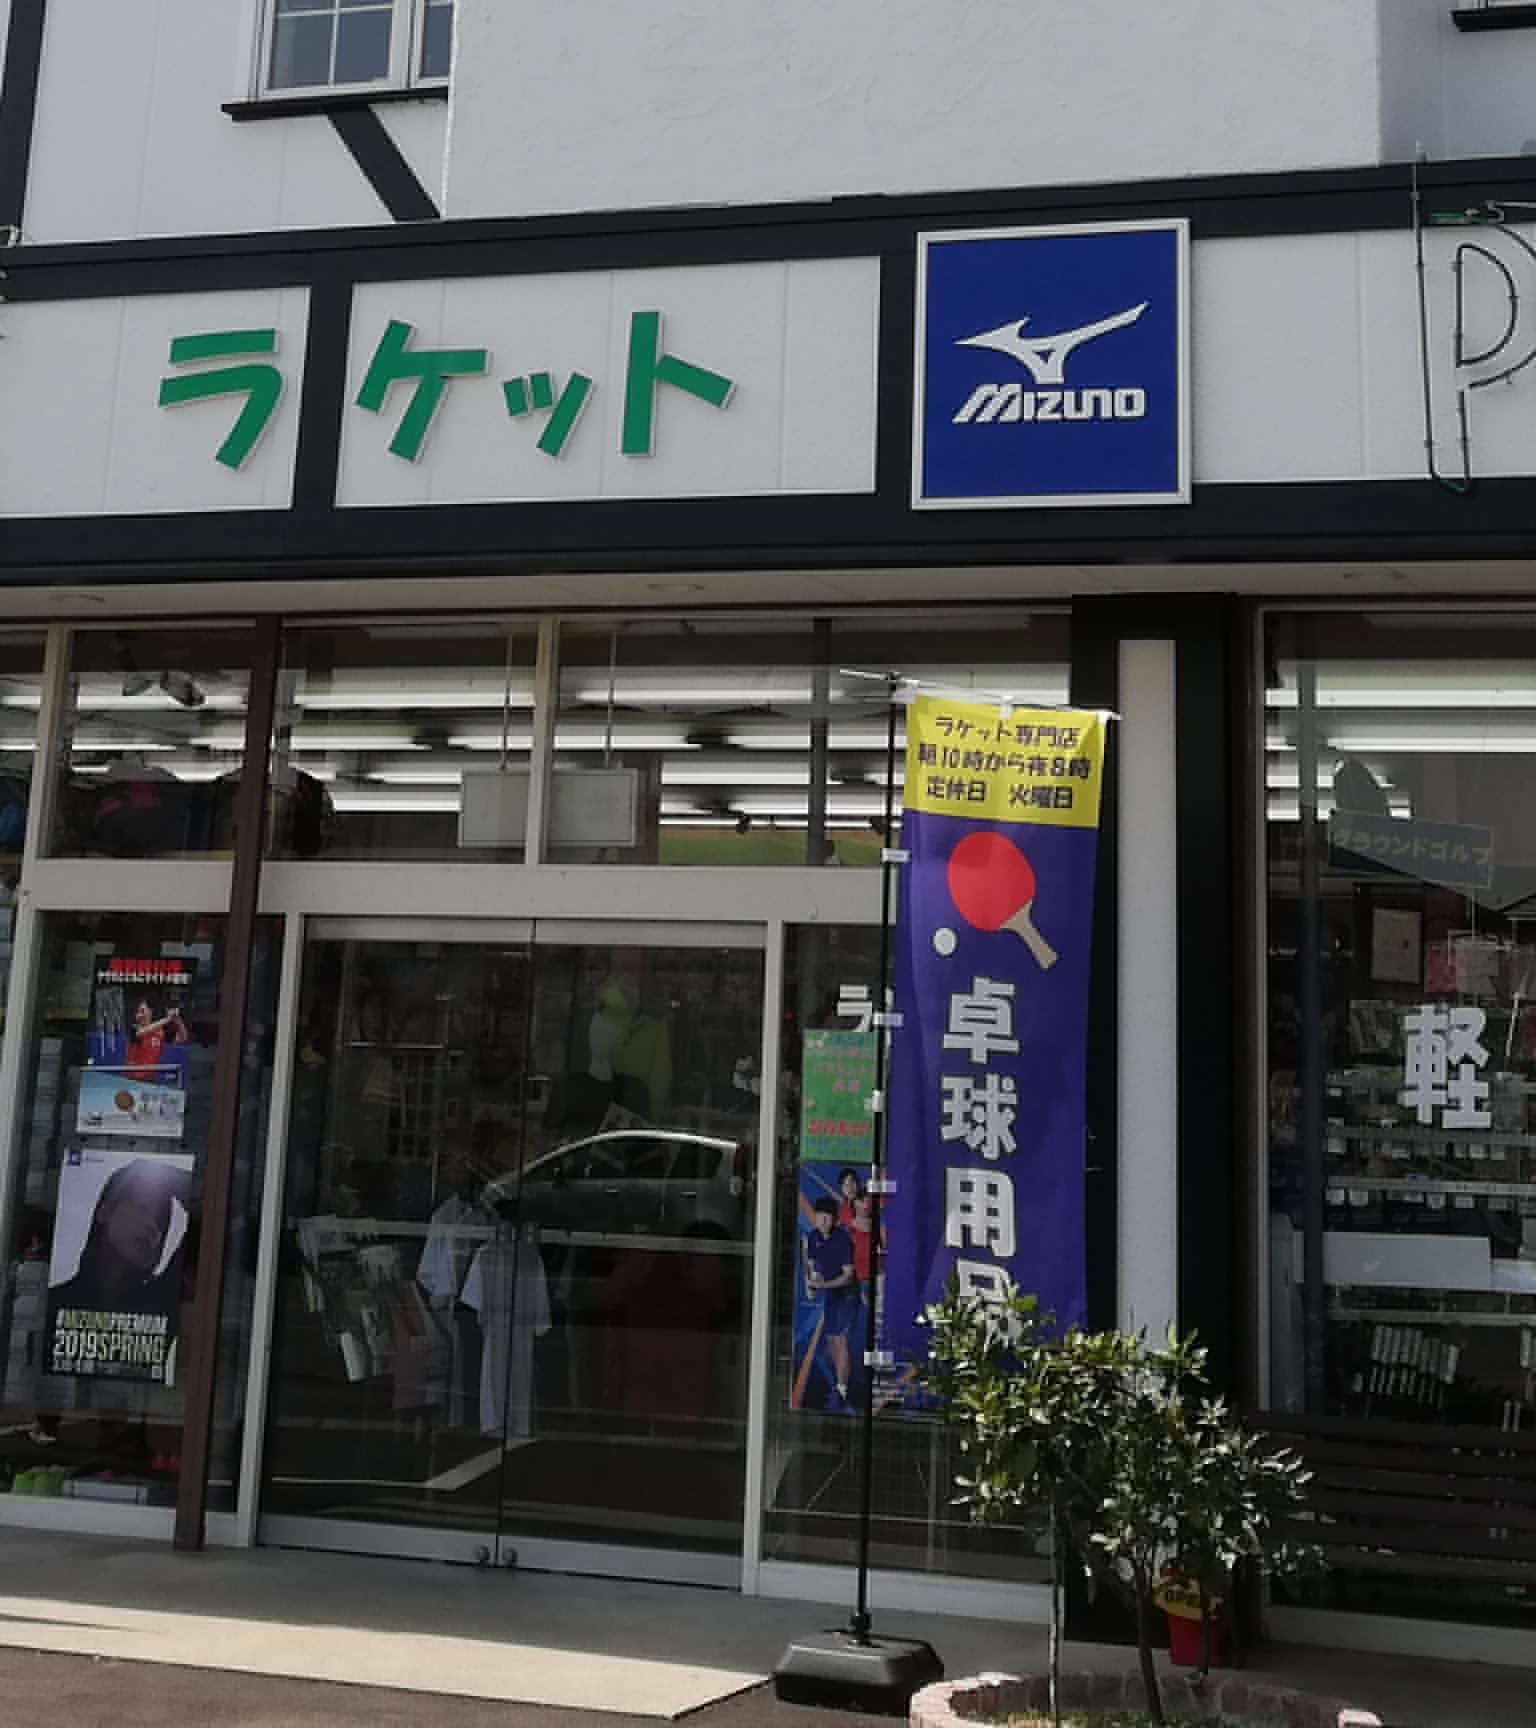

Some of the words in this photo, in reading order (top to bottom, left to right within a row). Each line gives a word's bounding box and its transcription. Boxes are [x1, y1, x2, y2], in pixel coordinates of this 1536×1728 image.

[157, 309, 738, 471] ラケット
[935, 716, 1082, 747] ラケット専門店
[918, 743, 1091, 780] 朝10時から夜8時
[927, 776, 987, 802] 定休日
[1008, 783, 1074, 809] 火曜日
